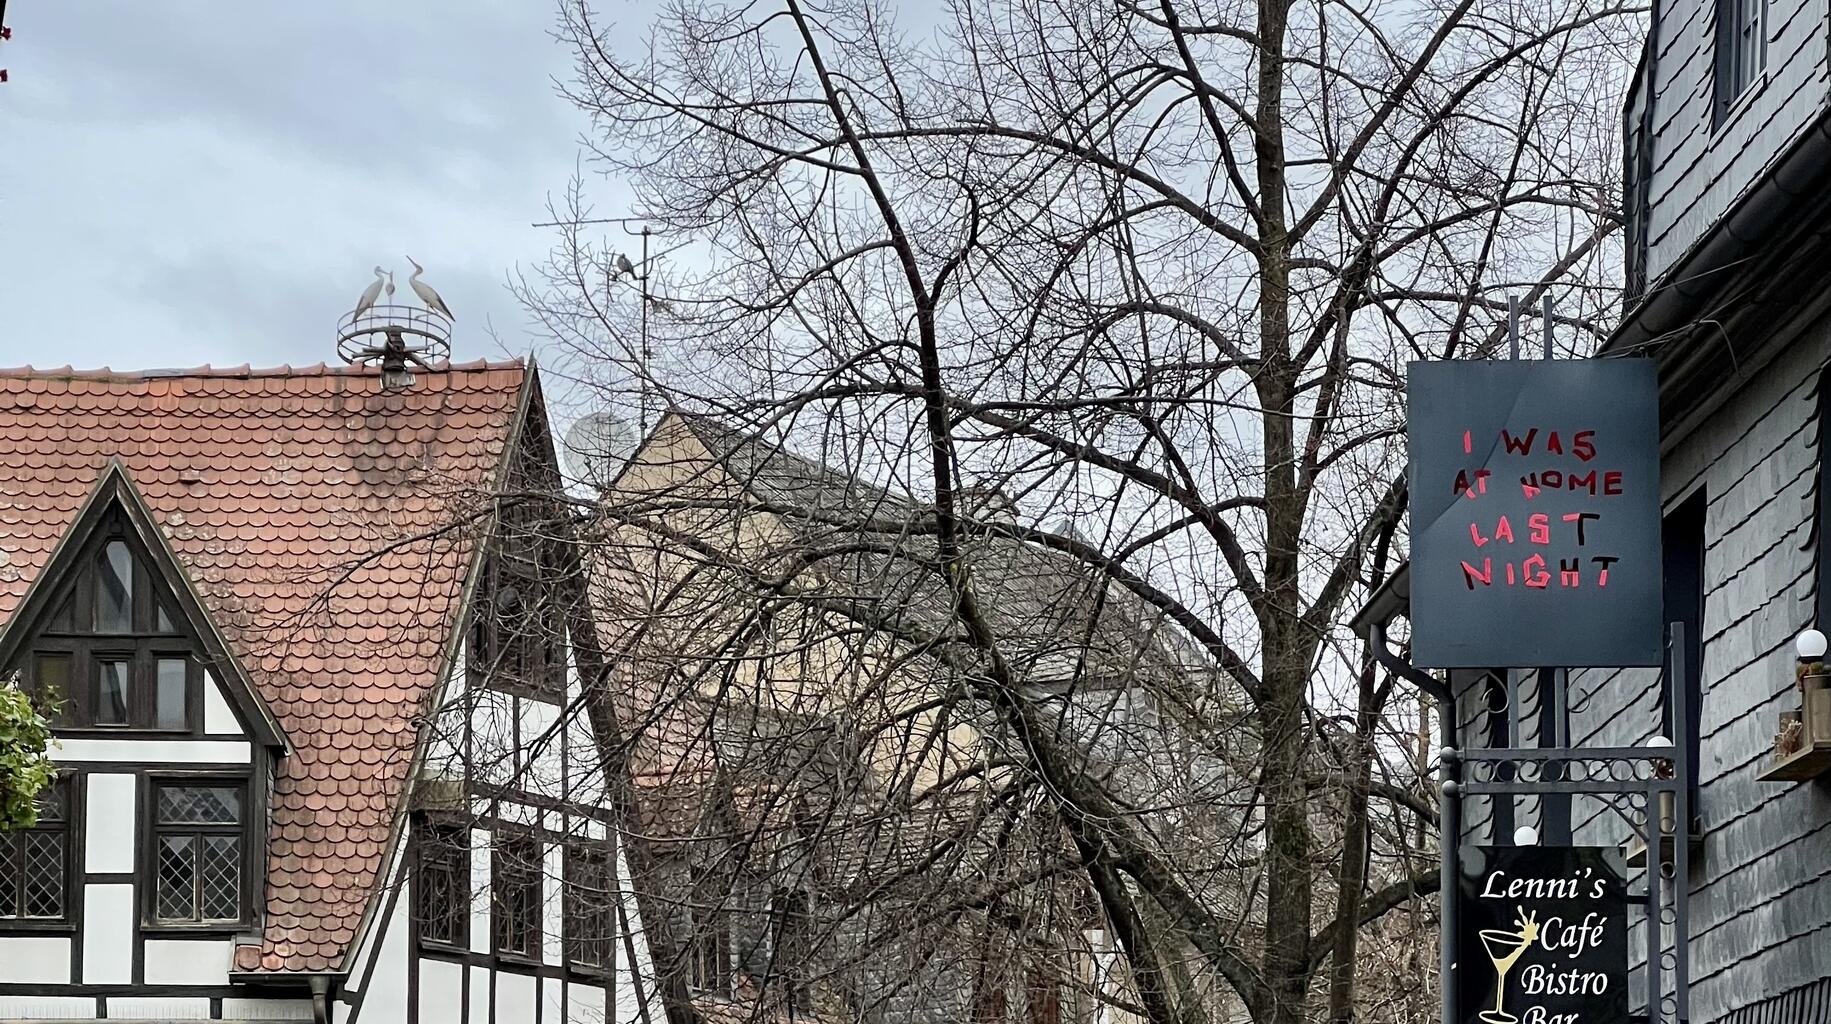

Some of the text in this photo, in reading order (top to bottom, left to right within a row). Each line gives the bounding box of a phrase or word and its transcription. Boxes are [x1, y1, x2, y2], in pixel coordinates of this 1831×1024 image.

[1463, 428, 1596, 462] I WAS
[1453, 469, 1624, 502] AT HOME
[1468, 513, 1601, 548] LAST
[1459, 552, 1620, 591] NIGHT
[1479, 867, 1608, 900] Lenni's
[1540, 912, 1608, 959] Café
[1520, 963, 1609, 995] Bistro
